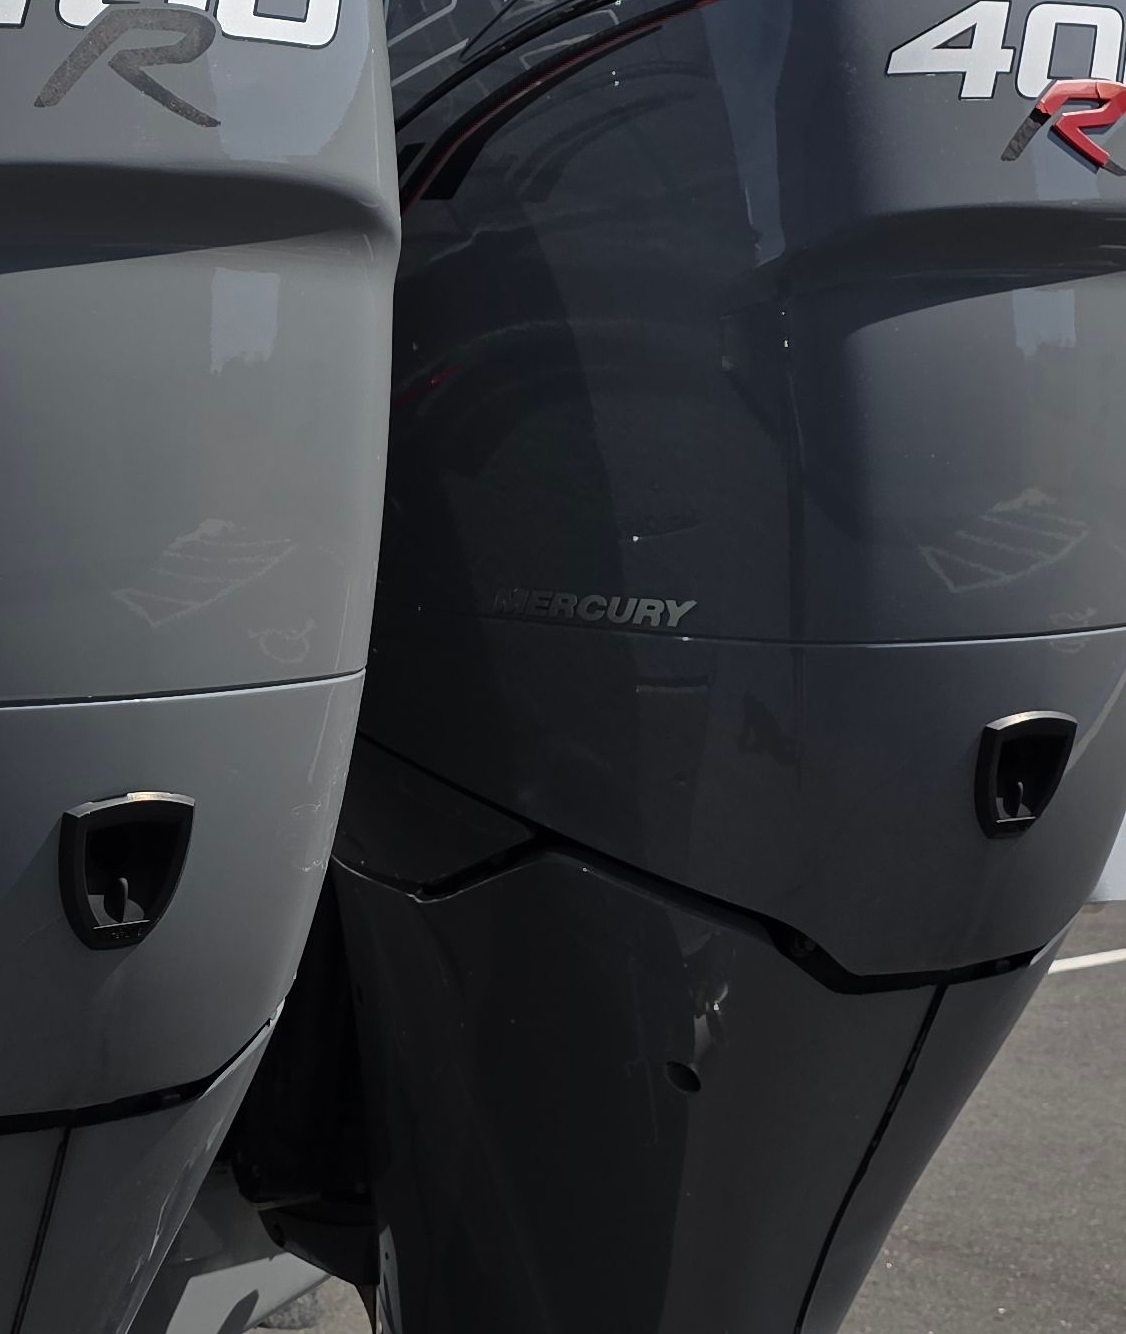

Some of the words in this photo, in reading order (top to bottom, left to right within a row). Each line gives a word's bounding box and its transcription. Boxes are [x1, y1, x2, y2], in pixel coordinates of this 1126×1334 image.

[34, 8, 220, 128] R
[887, 0, 1126, 100] 40
[492, 588, 698, 628] MERCURY
